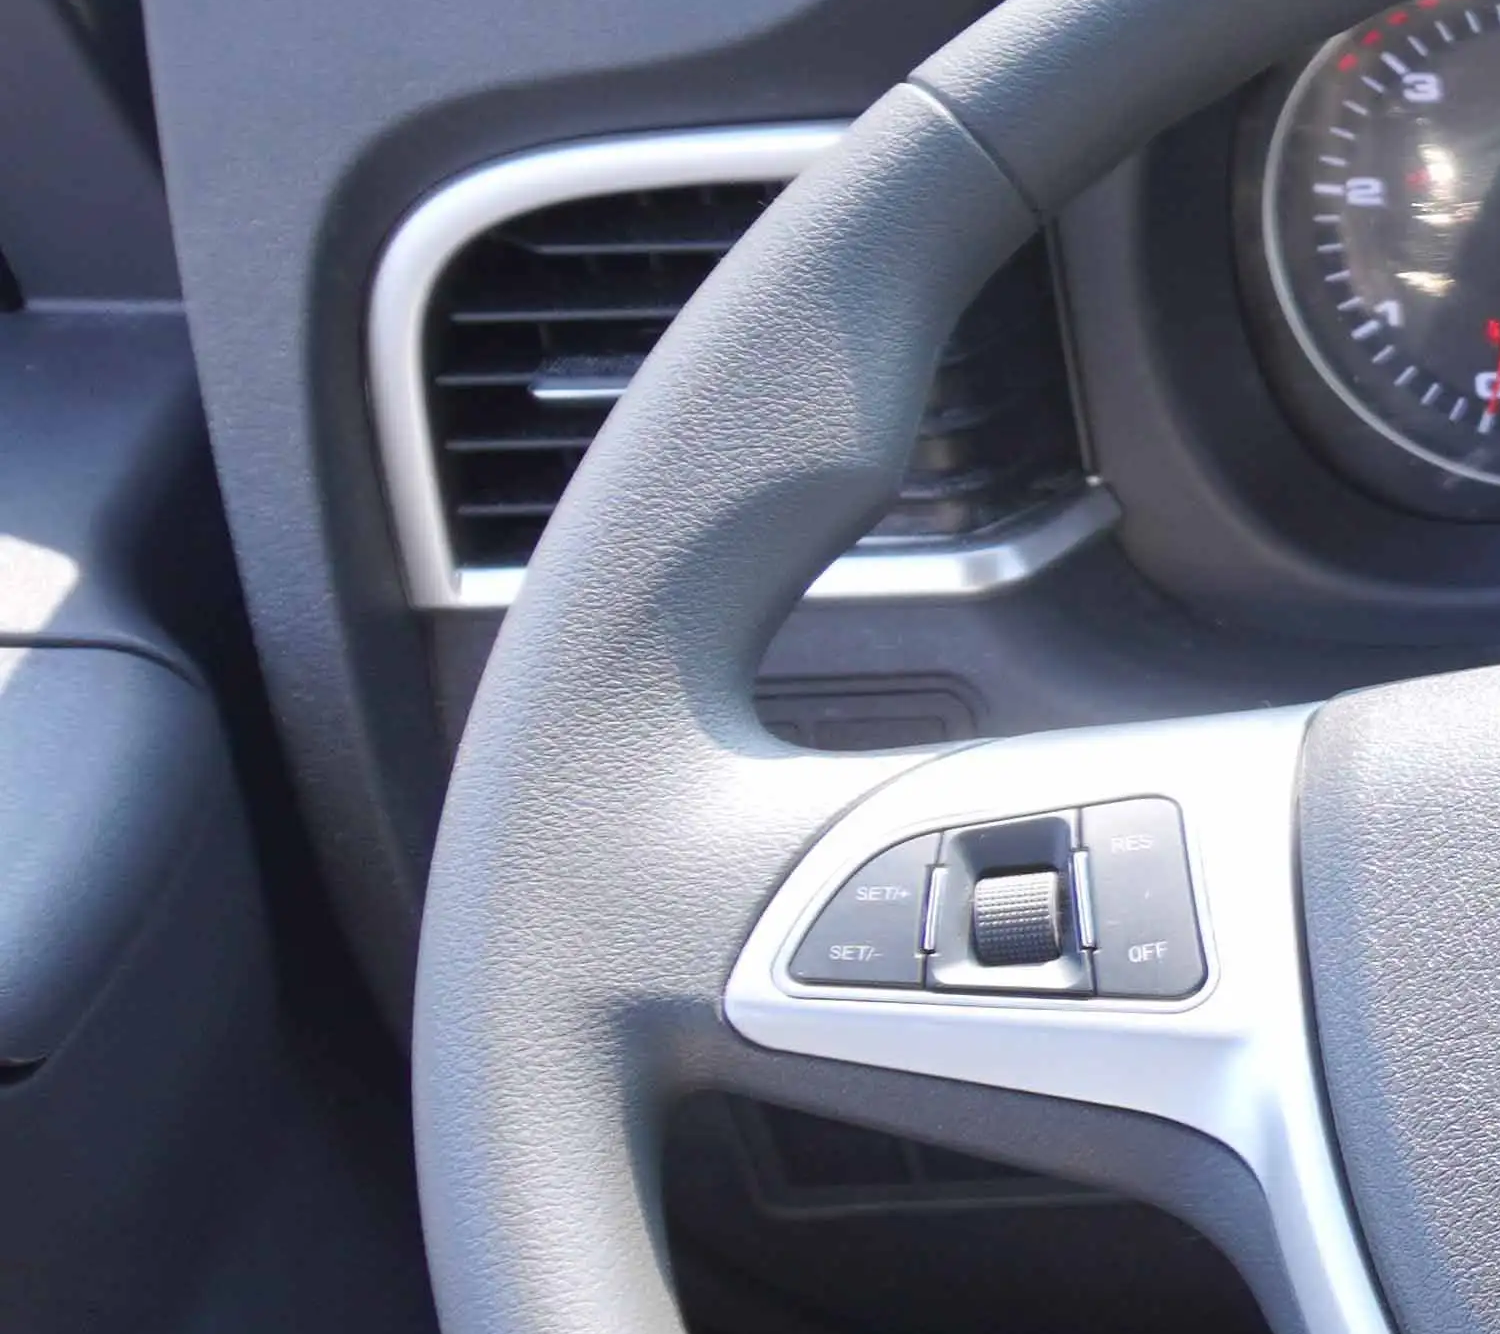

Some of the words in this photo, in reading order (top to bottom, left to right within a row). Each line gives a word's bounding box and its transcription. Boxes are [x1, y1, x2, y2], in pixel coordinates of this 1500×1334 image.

[1403, 74, 1442, 102] 3
[1346, 178, 1385, 207] 2
[1374, 302, 1402, 326] 1
[1111, 835, 1152, 852] RES
[855, 885, 912, 902] SET/+
[828, 944, 884, 962] SET/-
[1127, 942, 1168, 964] OFF
